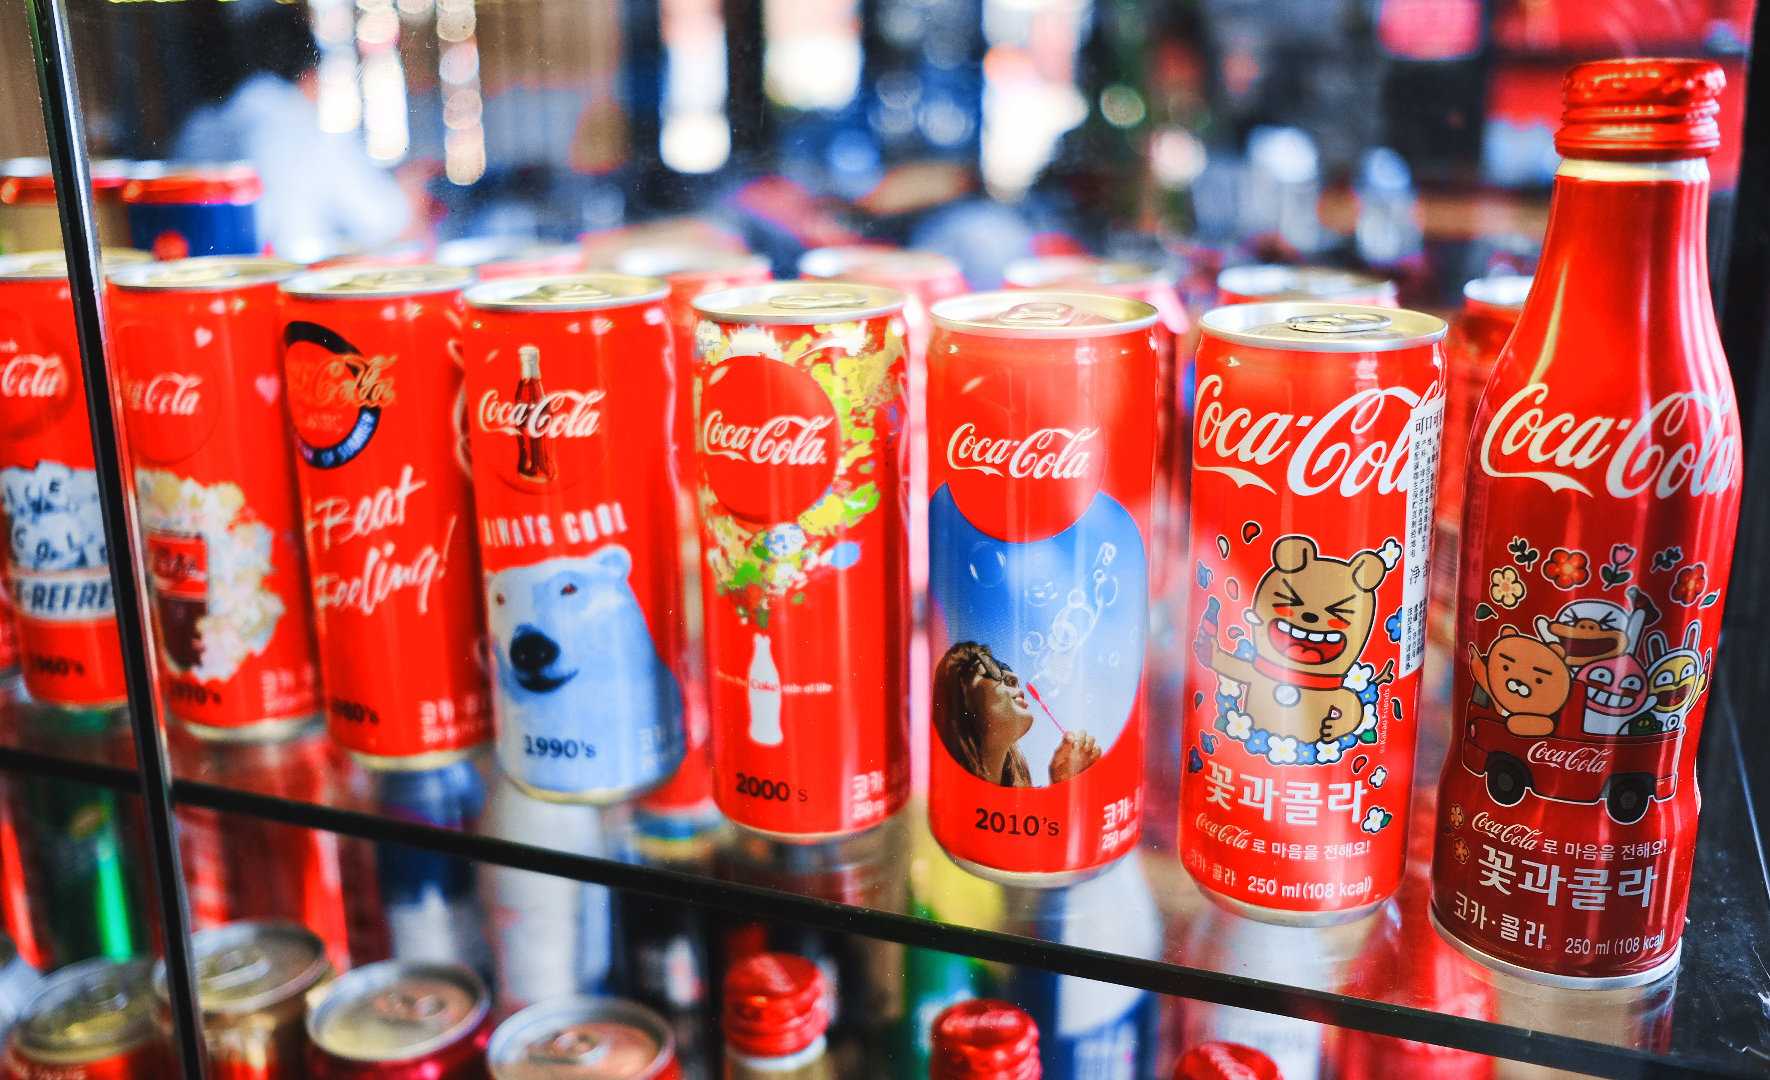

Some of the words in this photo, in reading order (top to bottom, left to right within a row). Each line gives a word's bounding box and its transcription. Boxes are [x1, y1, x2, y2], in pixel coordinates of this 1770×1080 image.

[478, 389, 607, 439] Coca-Cola
[703, 410, 835, 466] Coca-Cola
[1193, 374, 1440, 498] Coca-Col
[946, 422, 1100, 480] Coca-Cola
[1480, 382, 1737, 500] Coca-Cola
[561, 501, 628, 544] COOL
[524, 733, 597, 759] 1990's
[1526, 740, 1615, 773] Coca-Cola
[1204, 759, 1368, 826] 꽃과콜라
[974, 807, 1060, 837] 2010's
[1196, 812, 1253, 850] Coca-Cola
[1251, 838, 1267, 854] 로
[1271, 841, 1319, 861] 마음을
[1323, 840, 1371, 860] 전해요!
[1472, 811, 1544, 852] Coca-Cola
[1541, 839, 1558, 854] 로
[1564, 841, 1616, 861] 마음을
[1620, 839, 1668, 861] 전해요!
[1247, 875, 1277, 895] 250
[1338, 876, 1372, 898] kcal)
[1478, 844, 1659, 912] 꽃과콜라
[1564, 937, 1591, 955] 250
[1595, 939, 1610, 955] ml
[1614, 936, 1641, 956] (108
